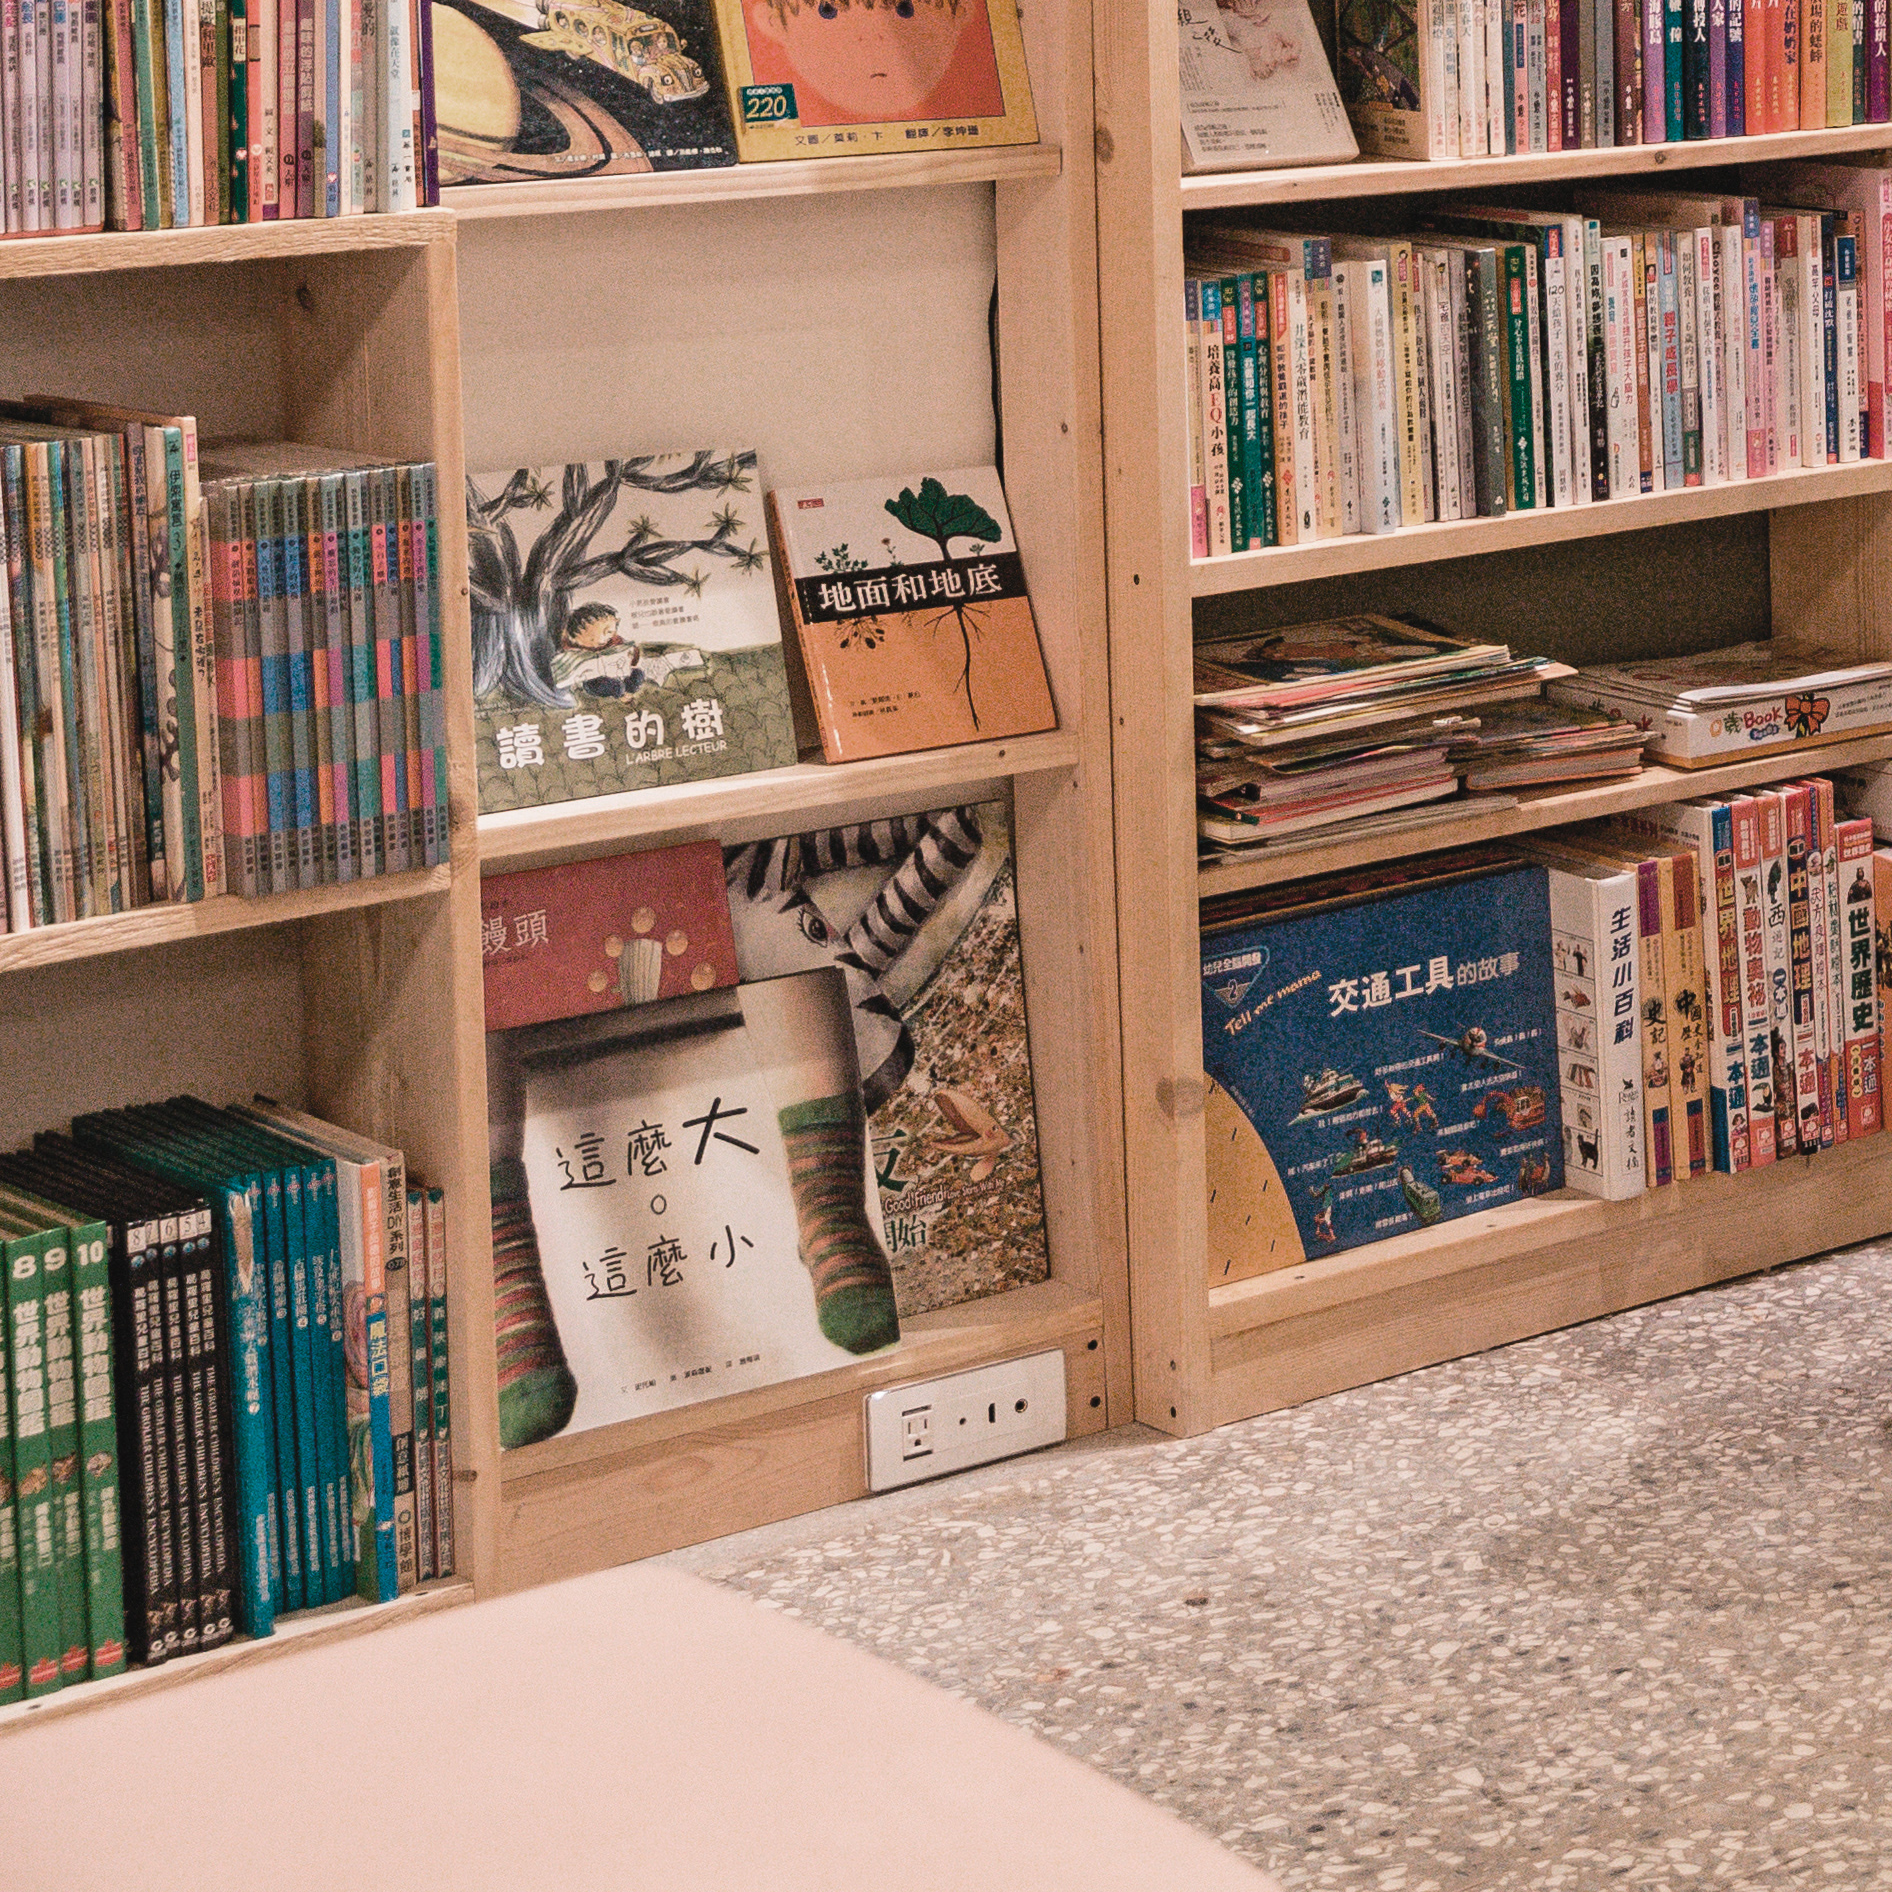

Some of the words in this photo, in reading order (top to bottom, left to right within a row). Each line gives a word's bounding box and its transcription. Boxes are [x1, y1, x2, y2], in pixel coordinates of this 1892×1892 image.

[746, 95, 787, 119] 220
[816, 562, 1003, 615] 地面和地底
[497, 698, 725, 771] 讀書的樹
[625, 746, 674, 766] L'ARBRE
[675, 740, 728, 761] LECTEUR
[480, 908, 549, 957] 饅頭
[1715, 875, 1742, 1008] 世界地理
[1769, 909, 1787, 960] 西遊記
[1790, 866, 1813, 992] 中國地理
[1224, 1009, 1253, 1036] Tell
[1254, 997, 1275, 1016] me
[1276, 969, 1323, 1000] mama
[1327, 951, 1520, 1018] 交通工具的故事
[1610, 905, 1635, 1046] 生活小百科
[1847, 909, 1874, 1032] 世界歷史
[555, 1096, 760, 1191] 這麼大
[12, 1254, 38, 1279] 8
[43, 1247, 67, 1271] 9
[77, 1240, 104, 1267] 10
[581, 1225, 754, 1302] 這麼小
